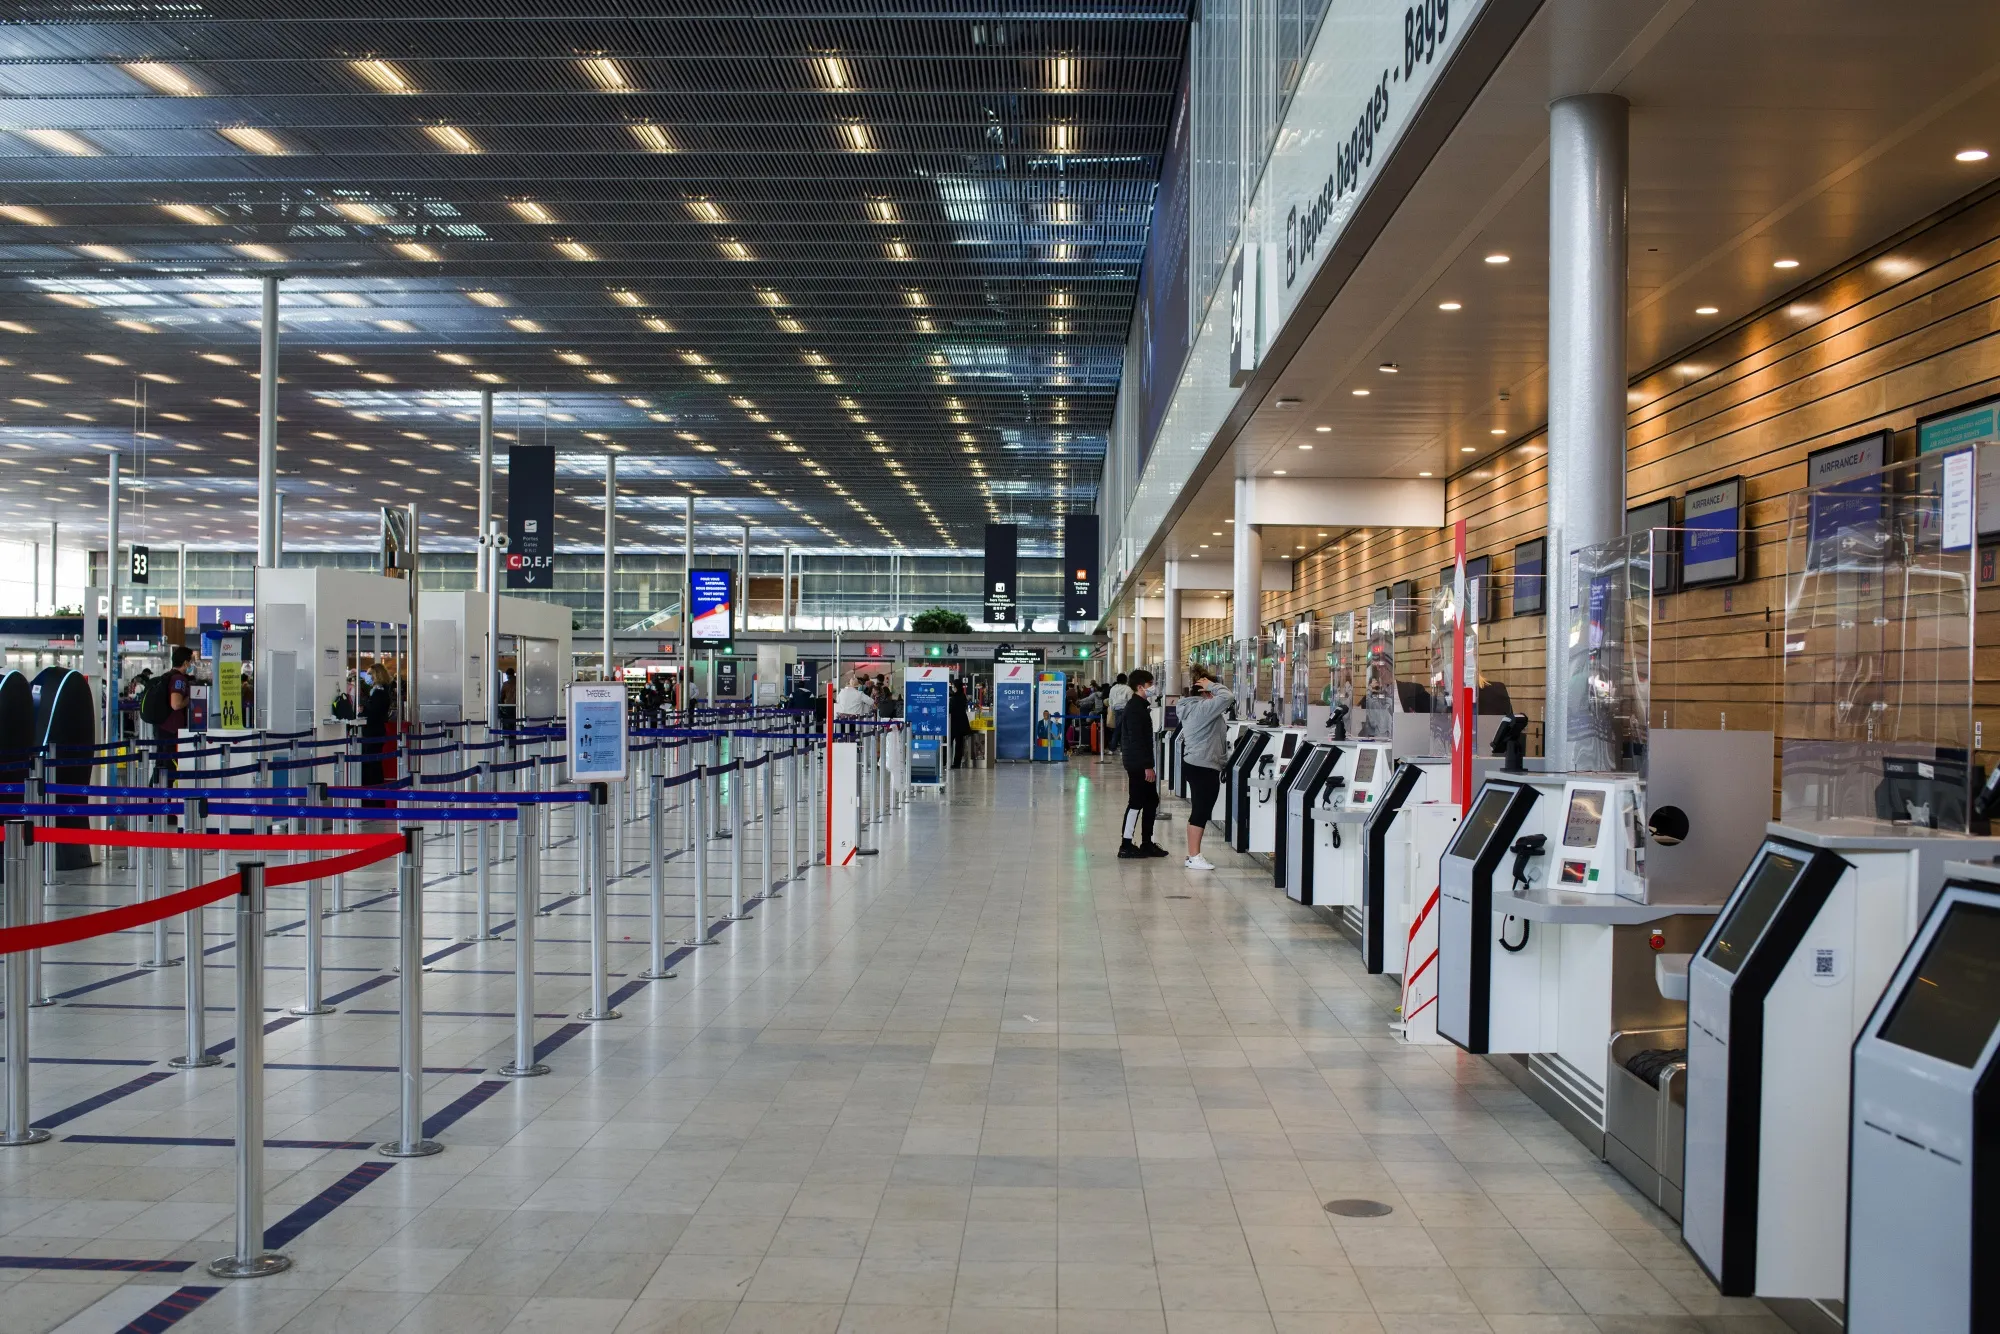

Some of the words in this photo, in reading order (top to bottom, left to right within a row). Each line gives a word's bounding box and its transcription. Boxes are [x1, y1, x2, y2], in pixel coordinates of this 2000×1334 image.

[1300, 174, 1334, 265] Dépose
[1337, 69, 1389, 200] bagages
[133, 553, 147, 575] 33
[1983, 565, 1993, 579] 07
[994, 612, 1005, 620] 36
[587, 690, 611, 698] Protect
[1886, 762, 1904, 772] Lenovo
